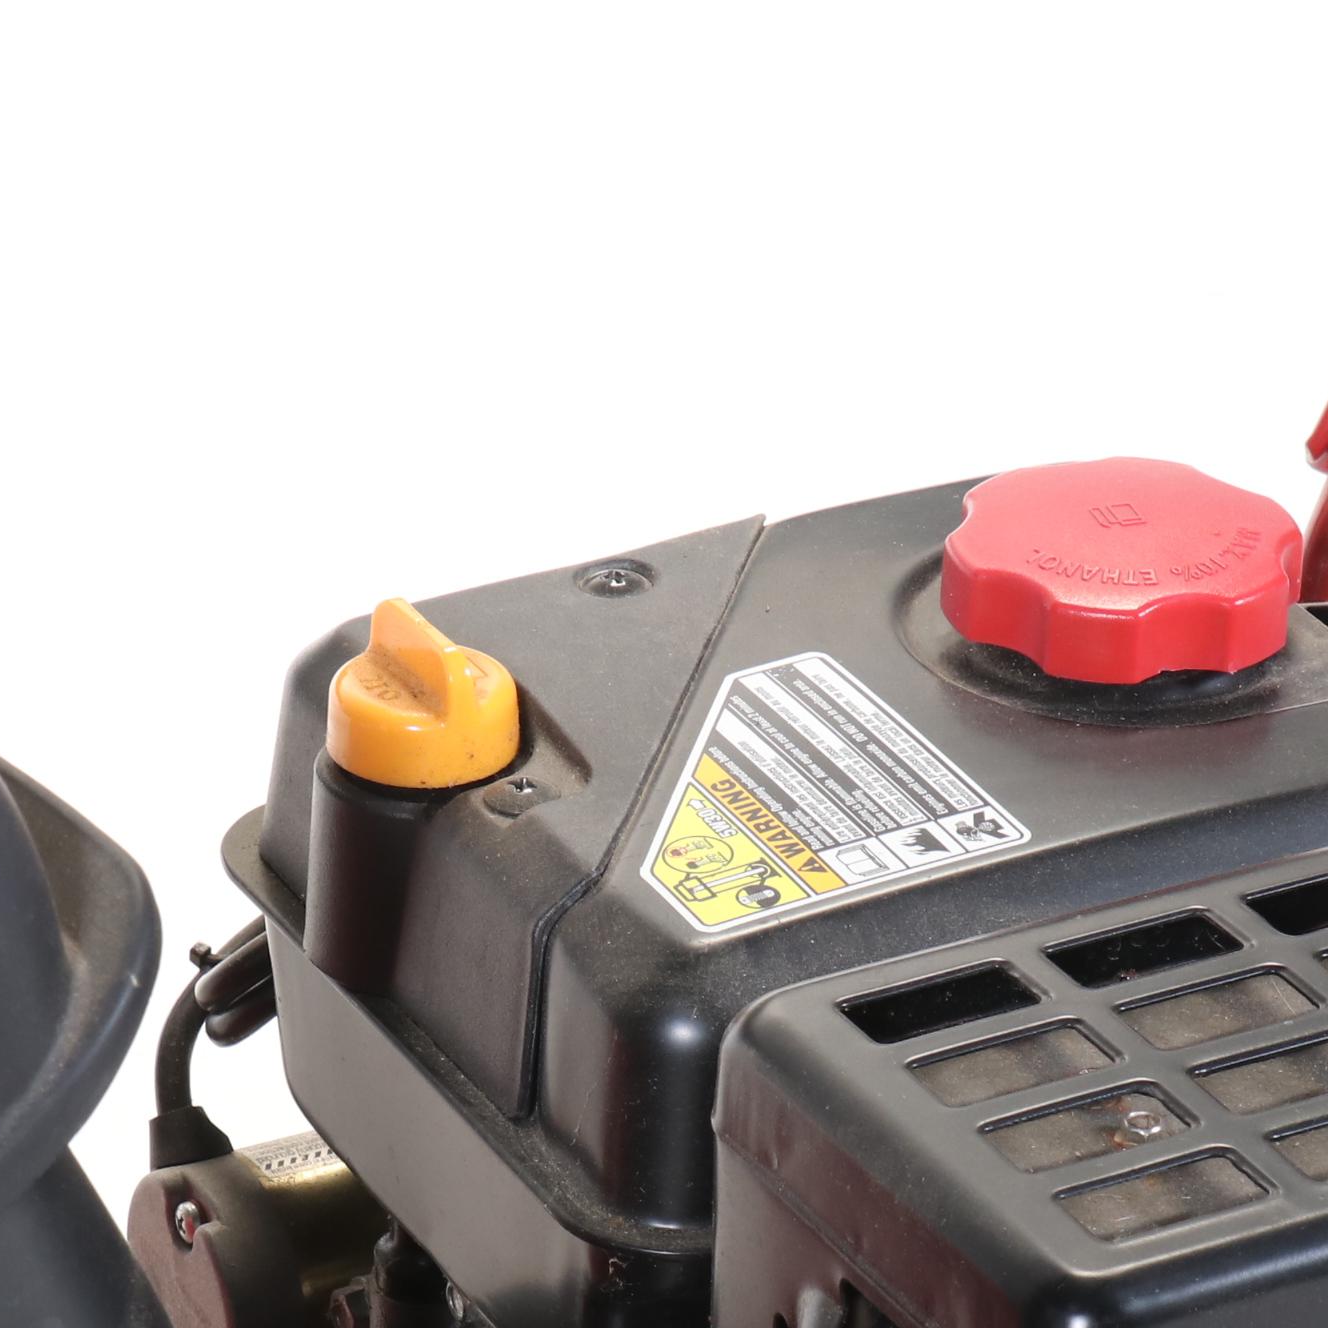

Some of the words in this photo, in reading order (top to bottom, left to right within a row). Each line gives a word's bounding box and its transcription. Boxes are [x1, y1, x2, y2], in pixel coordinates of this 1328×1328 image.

[1025, 547, 1160, 587] ETHANOL
[839, 722, 860, 734] NOT
[850, 732, 869, 742] DO
[804, 763, 828, 778] Allow
[888, 765, 915, 783] carbon
[749, 786, 786, 812] Operating
[917, 792, 952, 815] Engines
[697, 808, 738, 838] 5W30
[707, 778, 810, 858] WARNING
[854, 809, 887, 832] Gasoline
